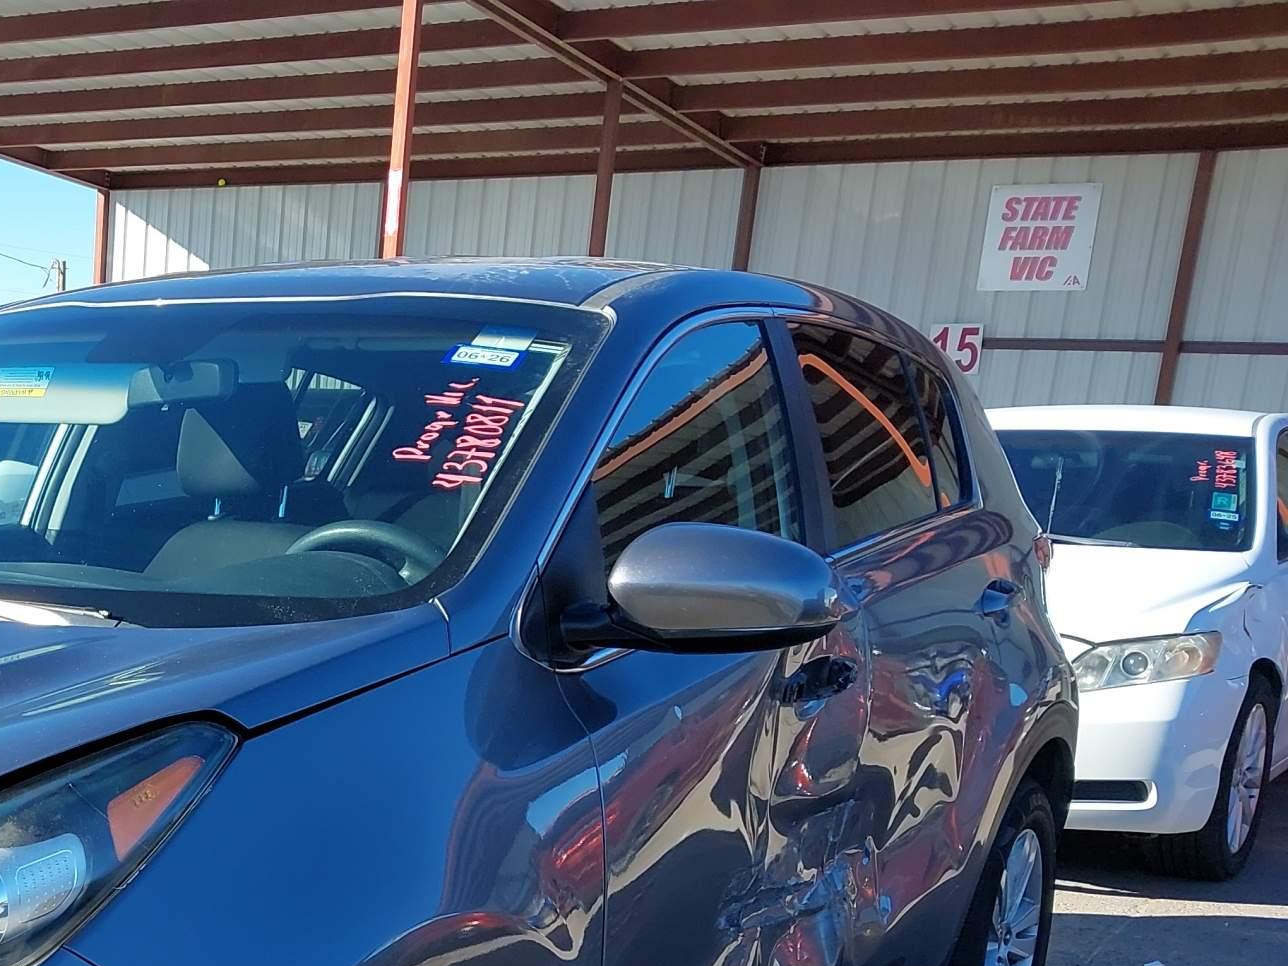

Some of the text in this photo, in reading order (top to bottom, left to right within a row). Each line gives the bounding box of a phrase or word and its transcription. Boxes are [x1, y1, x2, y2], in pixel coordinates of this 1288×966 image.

[1001, 195, 1082, 222] STATE
[998, 225, 1075, 251] FARM
[1009, 255, 1058, 281] VIC
[933, 326, 980, 373] 15
[432, 394, 525, 488] 43780811
